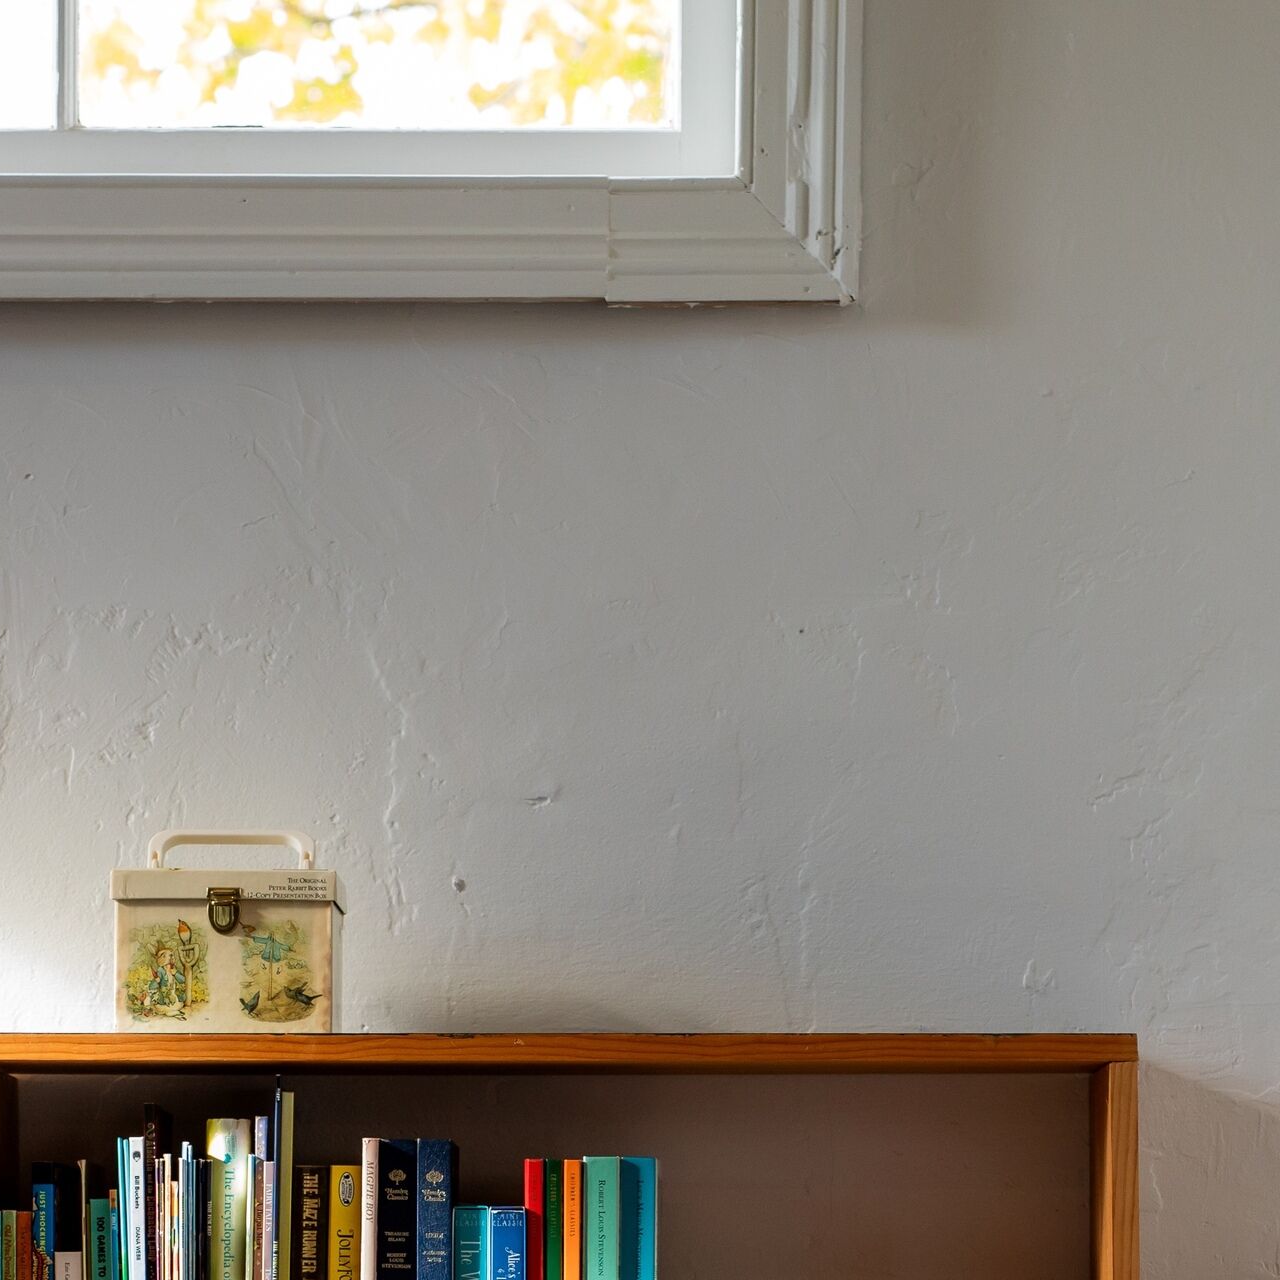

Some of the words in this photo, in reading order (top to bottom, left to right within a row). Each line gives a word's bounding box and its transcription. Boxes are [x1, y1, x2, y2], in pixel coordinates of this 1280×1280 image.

[224, 1168, 235, 1190] The
[302, 1174, 318, 1194] THE
[598, 1180, 606, 1209] ROBERT
[96, 1216, 106, 1232] 100
[302, 1198, 320, 1227] MAZE
[598, 1211, 606, 1233] LOUIS
[221, 1194, 235, 1268] Encyclopedia
[97, 1234, 106, 1264] GAMES
[302, 1230, 318, 1272] RUNNER
[337, 1229, 354, 1269] JOLLY
[460, 1236, 482, 1264] The
[504, 1246, 520, 1279] Alice's
[598, 1234, 606, 1276] STEVENSON
[98, 1266, 106, 1278] TO
